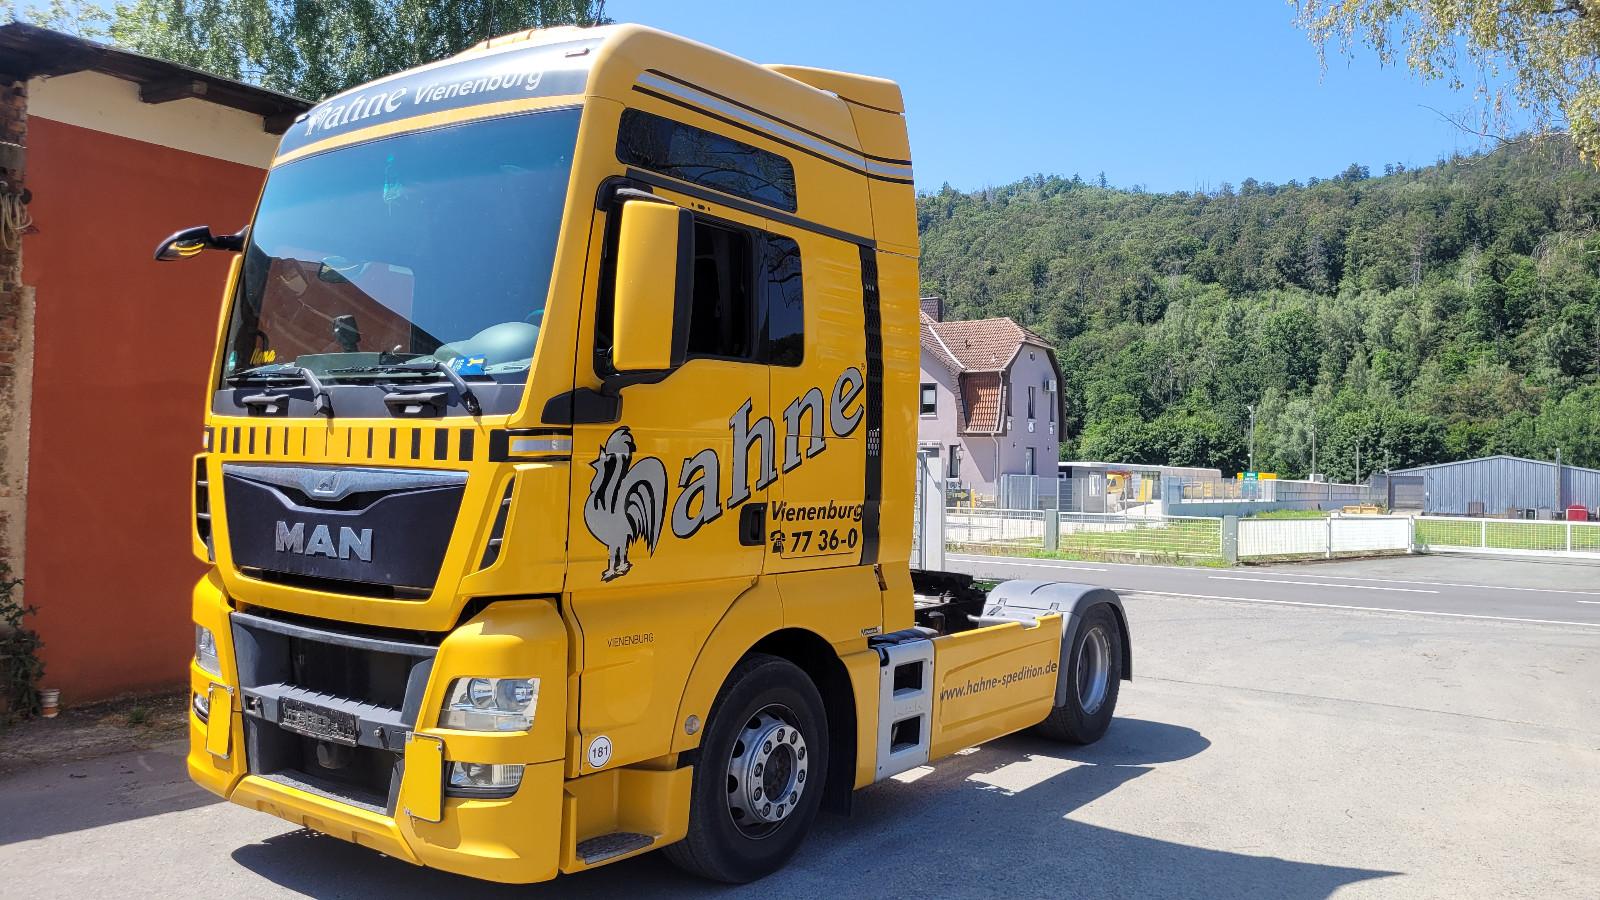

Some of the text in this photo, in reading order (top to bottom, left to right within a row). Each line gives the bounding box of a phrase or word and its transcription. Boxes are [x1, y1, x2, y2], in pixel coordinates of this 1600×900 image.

[414, 70, 543, 105] Vienenburg
[771, 500, 863, 522] Vienenburg
[275, 520, 373, 562] MAN
[791, 528, 858, 552] 77 36-0
[607, 633, 654, 647] VIENENBURG
[940, 660, 1058, 701] www.hahne-spedition.de
[592, 745, 609, 759] 181
